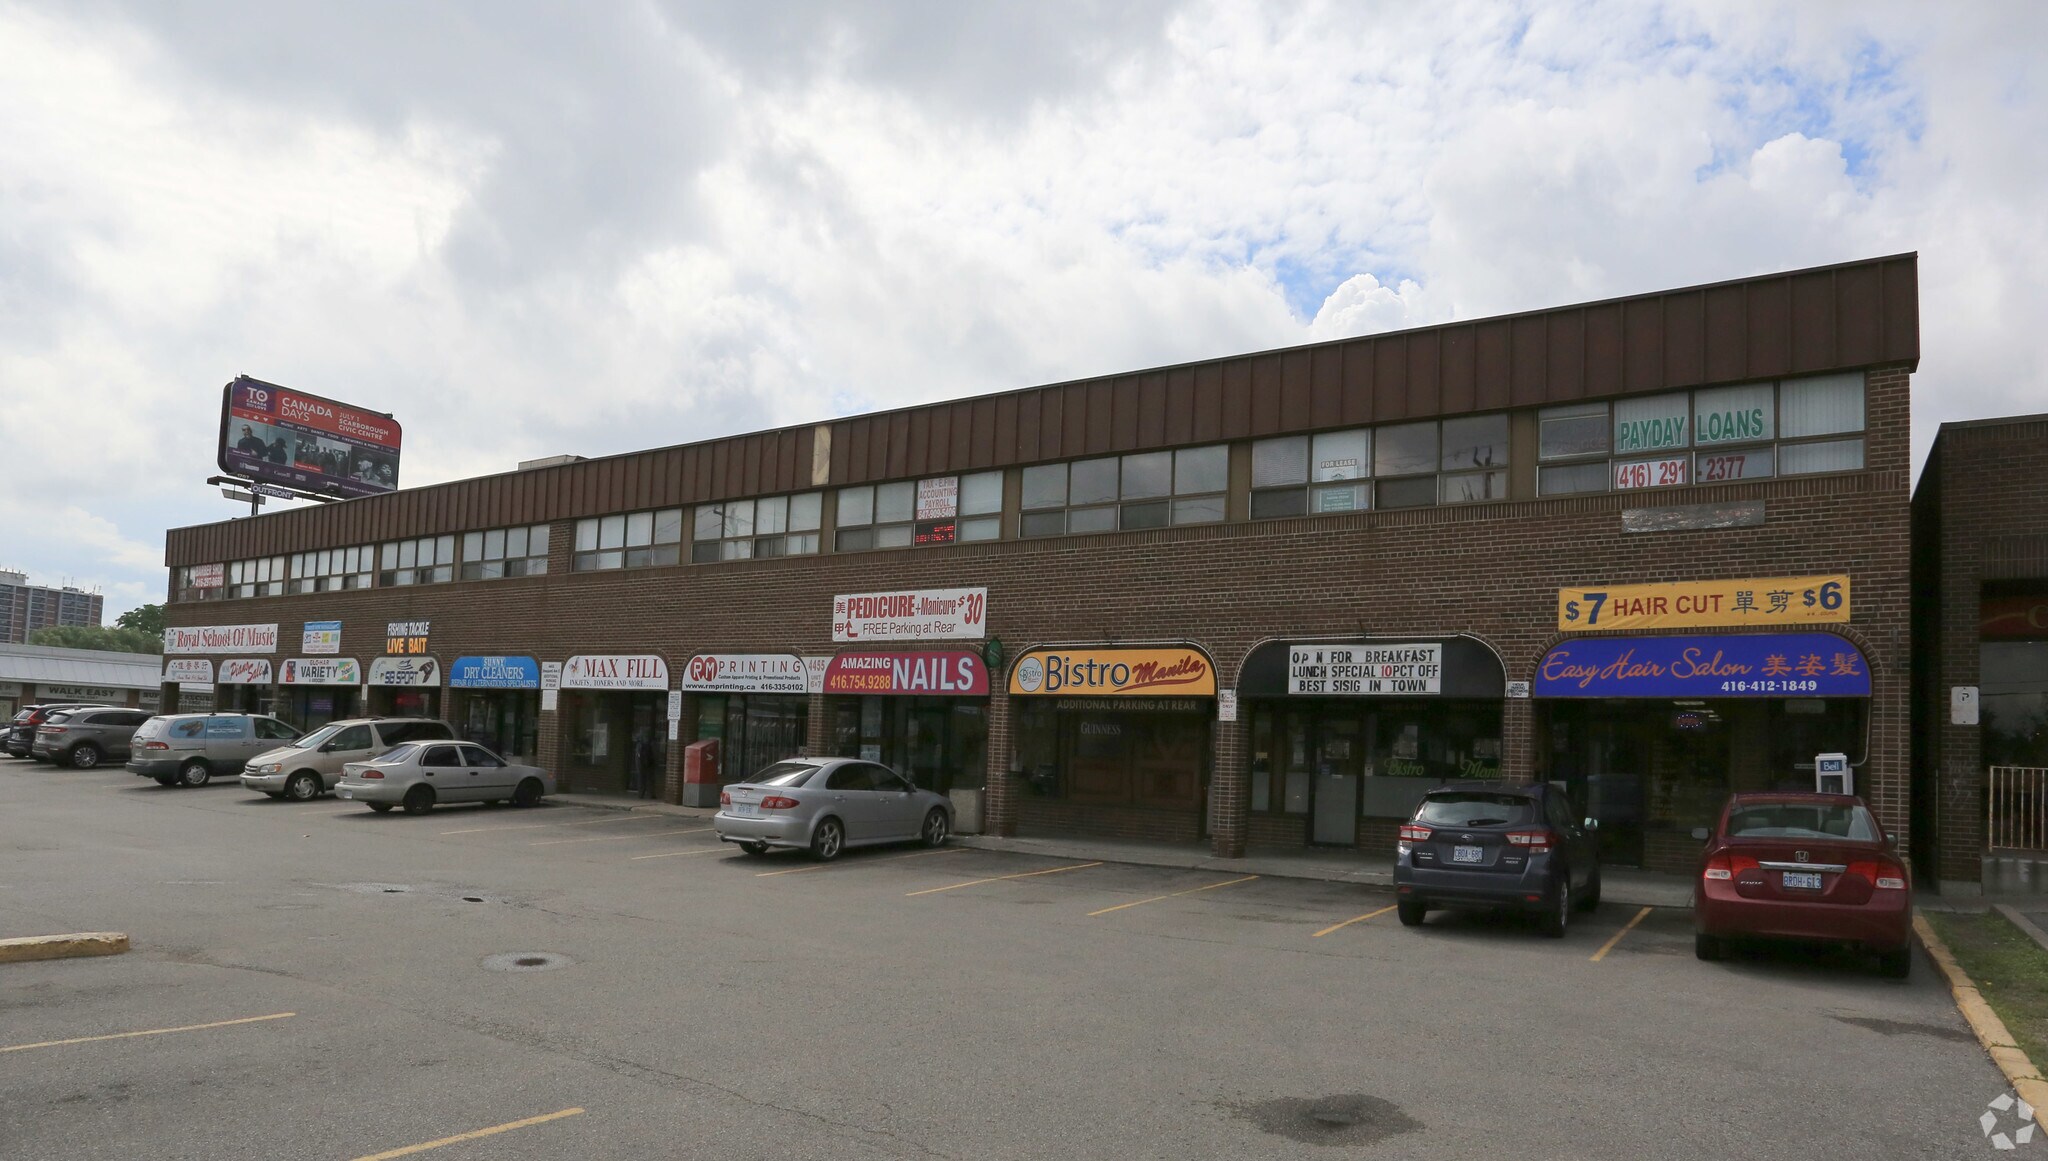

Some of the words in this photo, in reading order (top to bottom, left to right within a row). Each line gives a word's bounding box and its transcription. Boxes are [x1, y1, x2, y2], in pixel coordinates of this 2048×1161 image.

[246, 387, 268, 402] TO
[281, 406, 310, 422] DAYS
[282, 397, 333, 418] CANADA
[339, 412, 354, 421] JULY
[338, 418, 389, 436] SCARBOROUGH
[338, 424, 357, 434] CIVIC
[357, 429, 383, 441] CENTRE
[1619, 415, 1686, 450] PAYDAY
[1697, 408, 1763, 443] LOANS
[1335, 459, 1356, 467] LEASE
[1614, 462, 1651, 489] (416)
[1659, 459, 1687, 485] 291
[1706, 455, 1746, 481] 2377
[252, 485, 293, 499] OUTFRONT
[918, 487, 957, 500] ACCOUNTING
[924, 498, 950, 509] PAYROLL
[847, 594, 916, 620] PEDICURE
[1565, 592, 1608, 626] $7
[1613, 596, 1668, 617] HAIR
[1675, 594, 1724, 614] CUT
[1802, 581, 1843, 611] $6
[387, 622, 408, 636] FISHING
[408, 621, 430, 636] TACKLE
[862, 622, 888, 635] FREE
[889, 621, 922, 637] Parking
[923, 621, 932, 633] at
[933, 620, 957, 633] Rear
[176, 629, 200, 650] Royal
[202, 628, 230, 647] School
[233, 627, 245, 647] Of
[246, 626, 275, 646] Music
[386, 637, 404, 654] LIVE
[408, 637, 427, 654] BAIT
[483, 657, 505, 667] SUNNY
[841, 657, 891, 669] AMAZING
[1330, 651, 1352, 662] FOR
[1365, 649, 1435, 663] BREAKFAST
[300, 666, 338, 678] VARIETY
[583, 658, 619, 678] MAX
[626, 658, 663, 679] FILL
[693, 661, 715, 679] RM
[718, 660, 801, 673] PRINTING
[808, 660, 825, 672] 4455
[1292, 664, 1327, 678] LUNCH
[1331, 664, 1376, 677] SPECIAL
[1418, 664, 1439, 677] OFF
[1542, 651, 1599, 689] Easy
[1600, 648, 1666, 681] Hair
[1671, 647, 1752, 678] Salon
[396, 671, 418, 685] SPORT
[463, 667, 481, 679] DRY
[481, 667, 524, 680] CLEANERS
[892, 656, 974, 691] NAILS
[1045, 655, 1131, 692] Bistro
[1132, 655, 1206, 684] Manila
[507, 680, 537, 688] SPECIALISTS
[685, 683, 756, 691] www.rmprinting.ca
[830, 674, 891, 690] 416.754.9288
[1299, 680, 1325, 692] BEST
[1332, 680, 1361, 692] SISIG
[1369, 680, 1381, 692] IN
[1391, 679, 1427, 692] TOWN
[1721, 680, 1818, 692] 416-412-1849
[49, 686, 83, 695] WALK
[86, 688, 116, 697] EASY
[1056, 700, 1112, 710] ADDITIONAL
[1113, 700, 1156, 710] PARKING
[1157, 701, 1171, 710] AT
[1171, 701, 1197, 711] REAR
[1080, 722, 1122, 735] GUINNESS
[1384, 759, 1425, 776] Bistro
[1823, 761, 1840, 771] Bell
